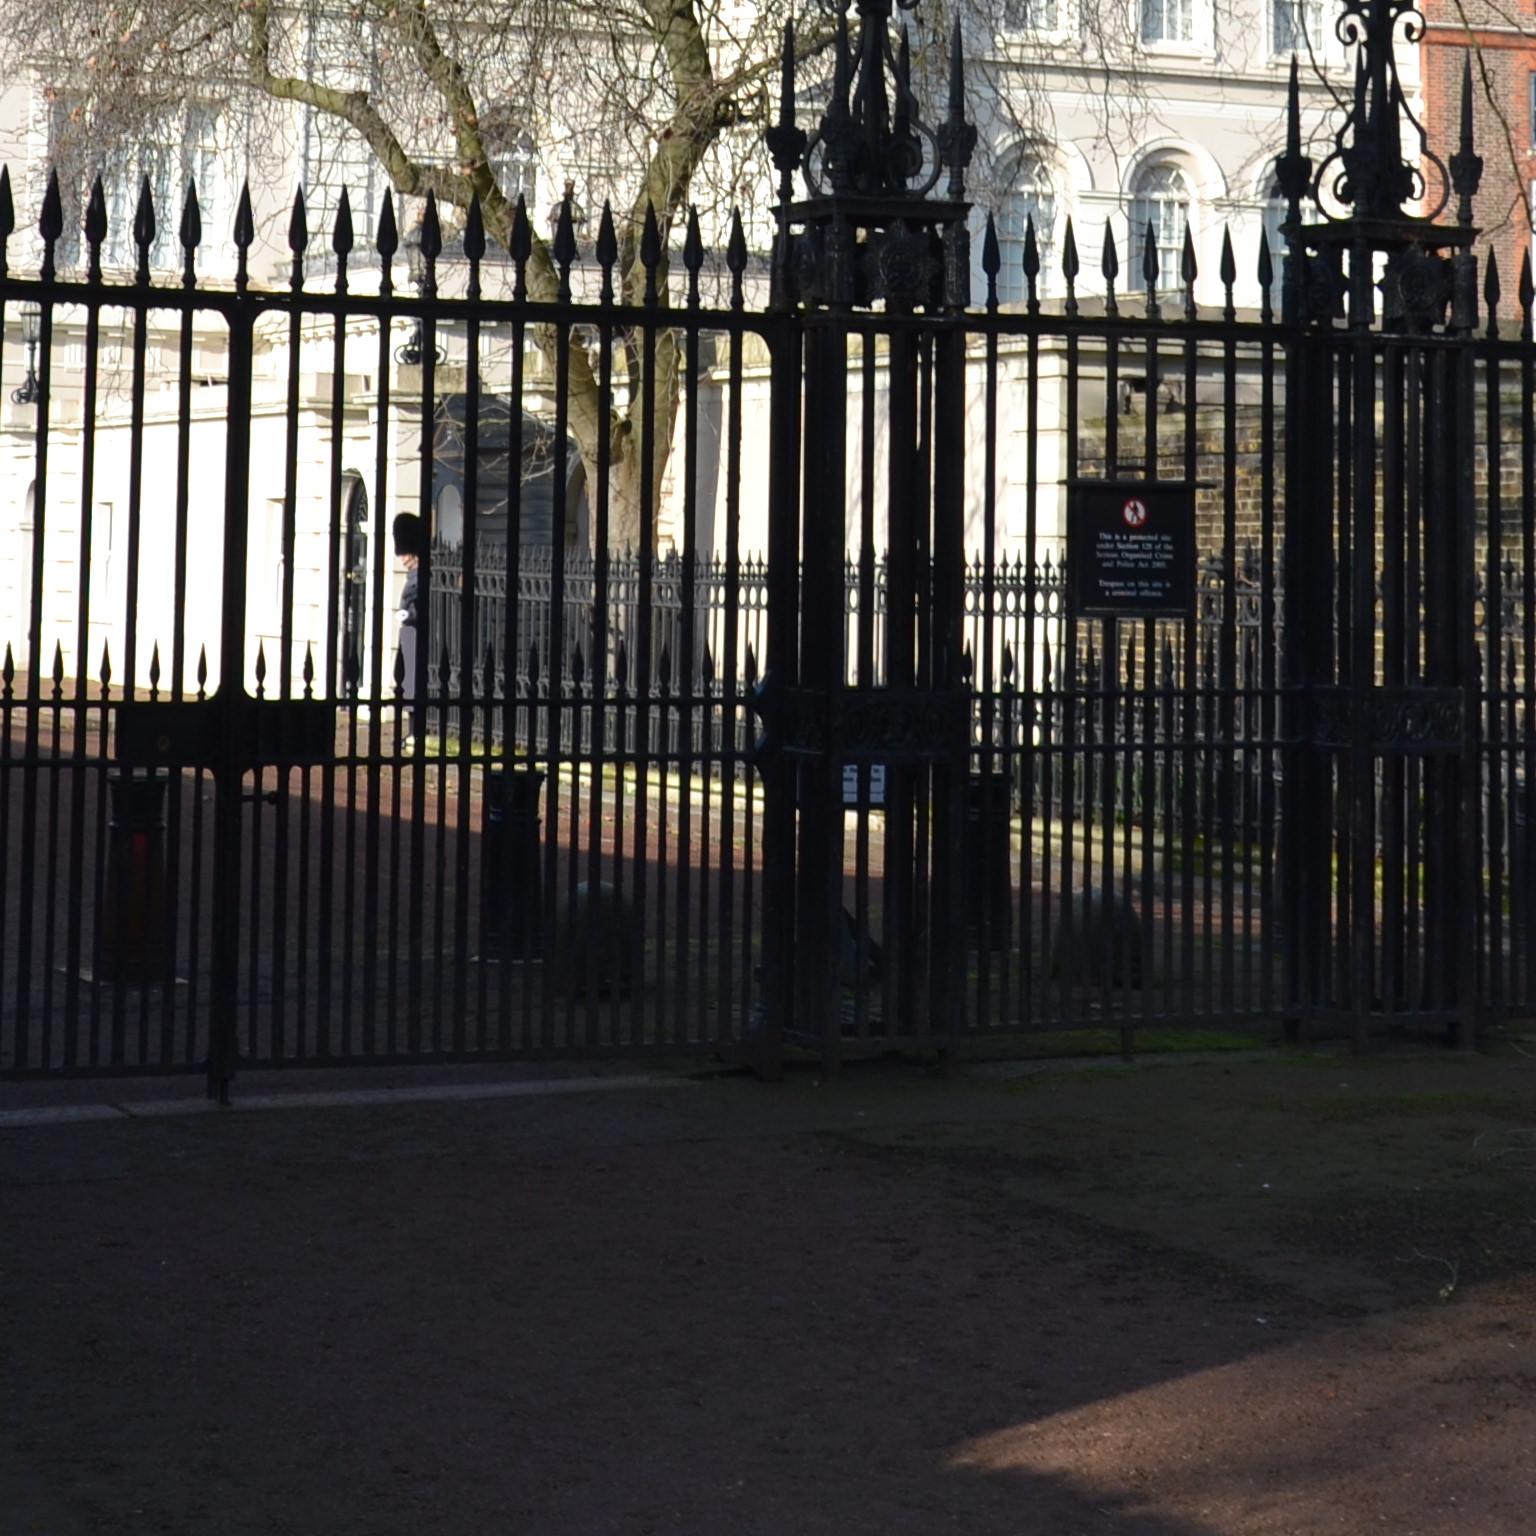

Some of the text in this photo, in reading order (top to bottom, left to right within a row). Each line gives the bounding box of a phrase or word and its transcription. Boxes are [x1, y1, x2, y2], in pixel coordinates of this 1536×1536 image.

[1099, 532, 1112, 540] This
[1129, 534, 1158, 542] protected
[1116, 542, 1139, 550] Section
